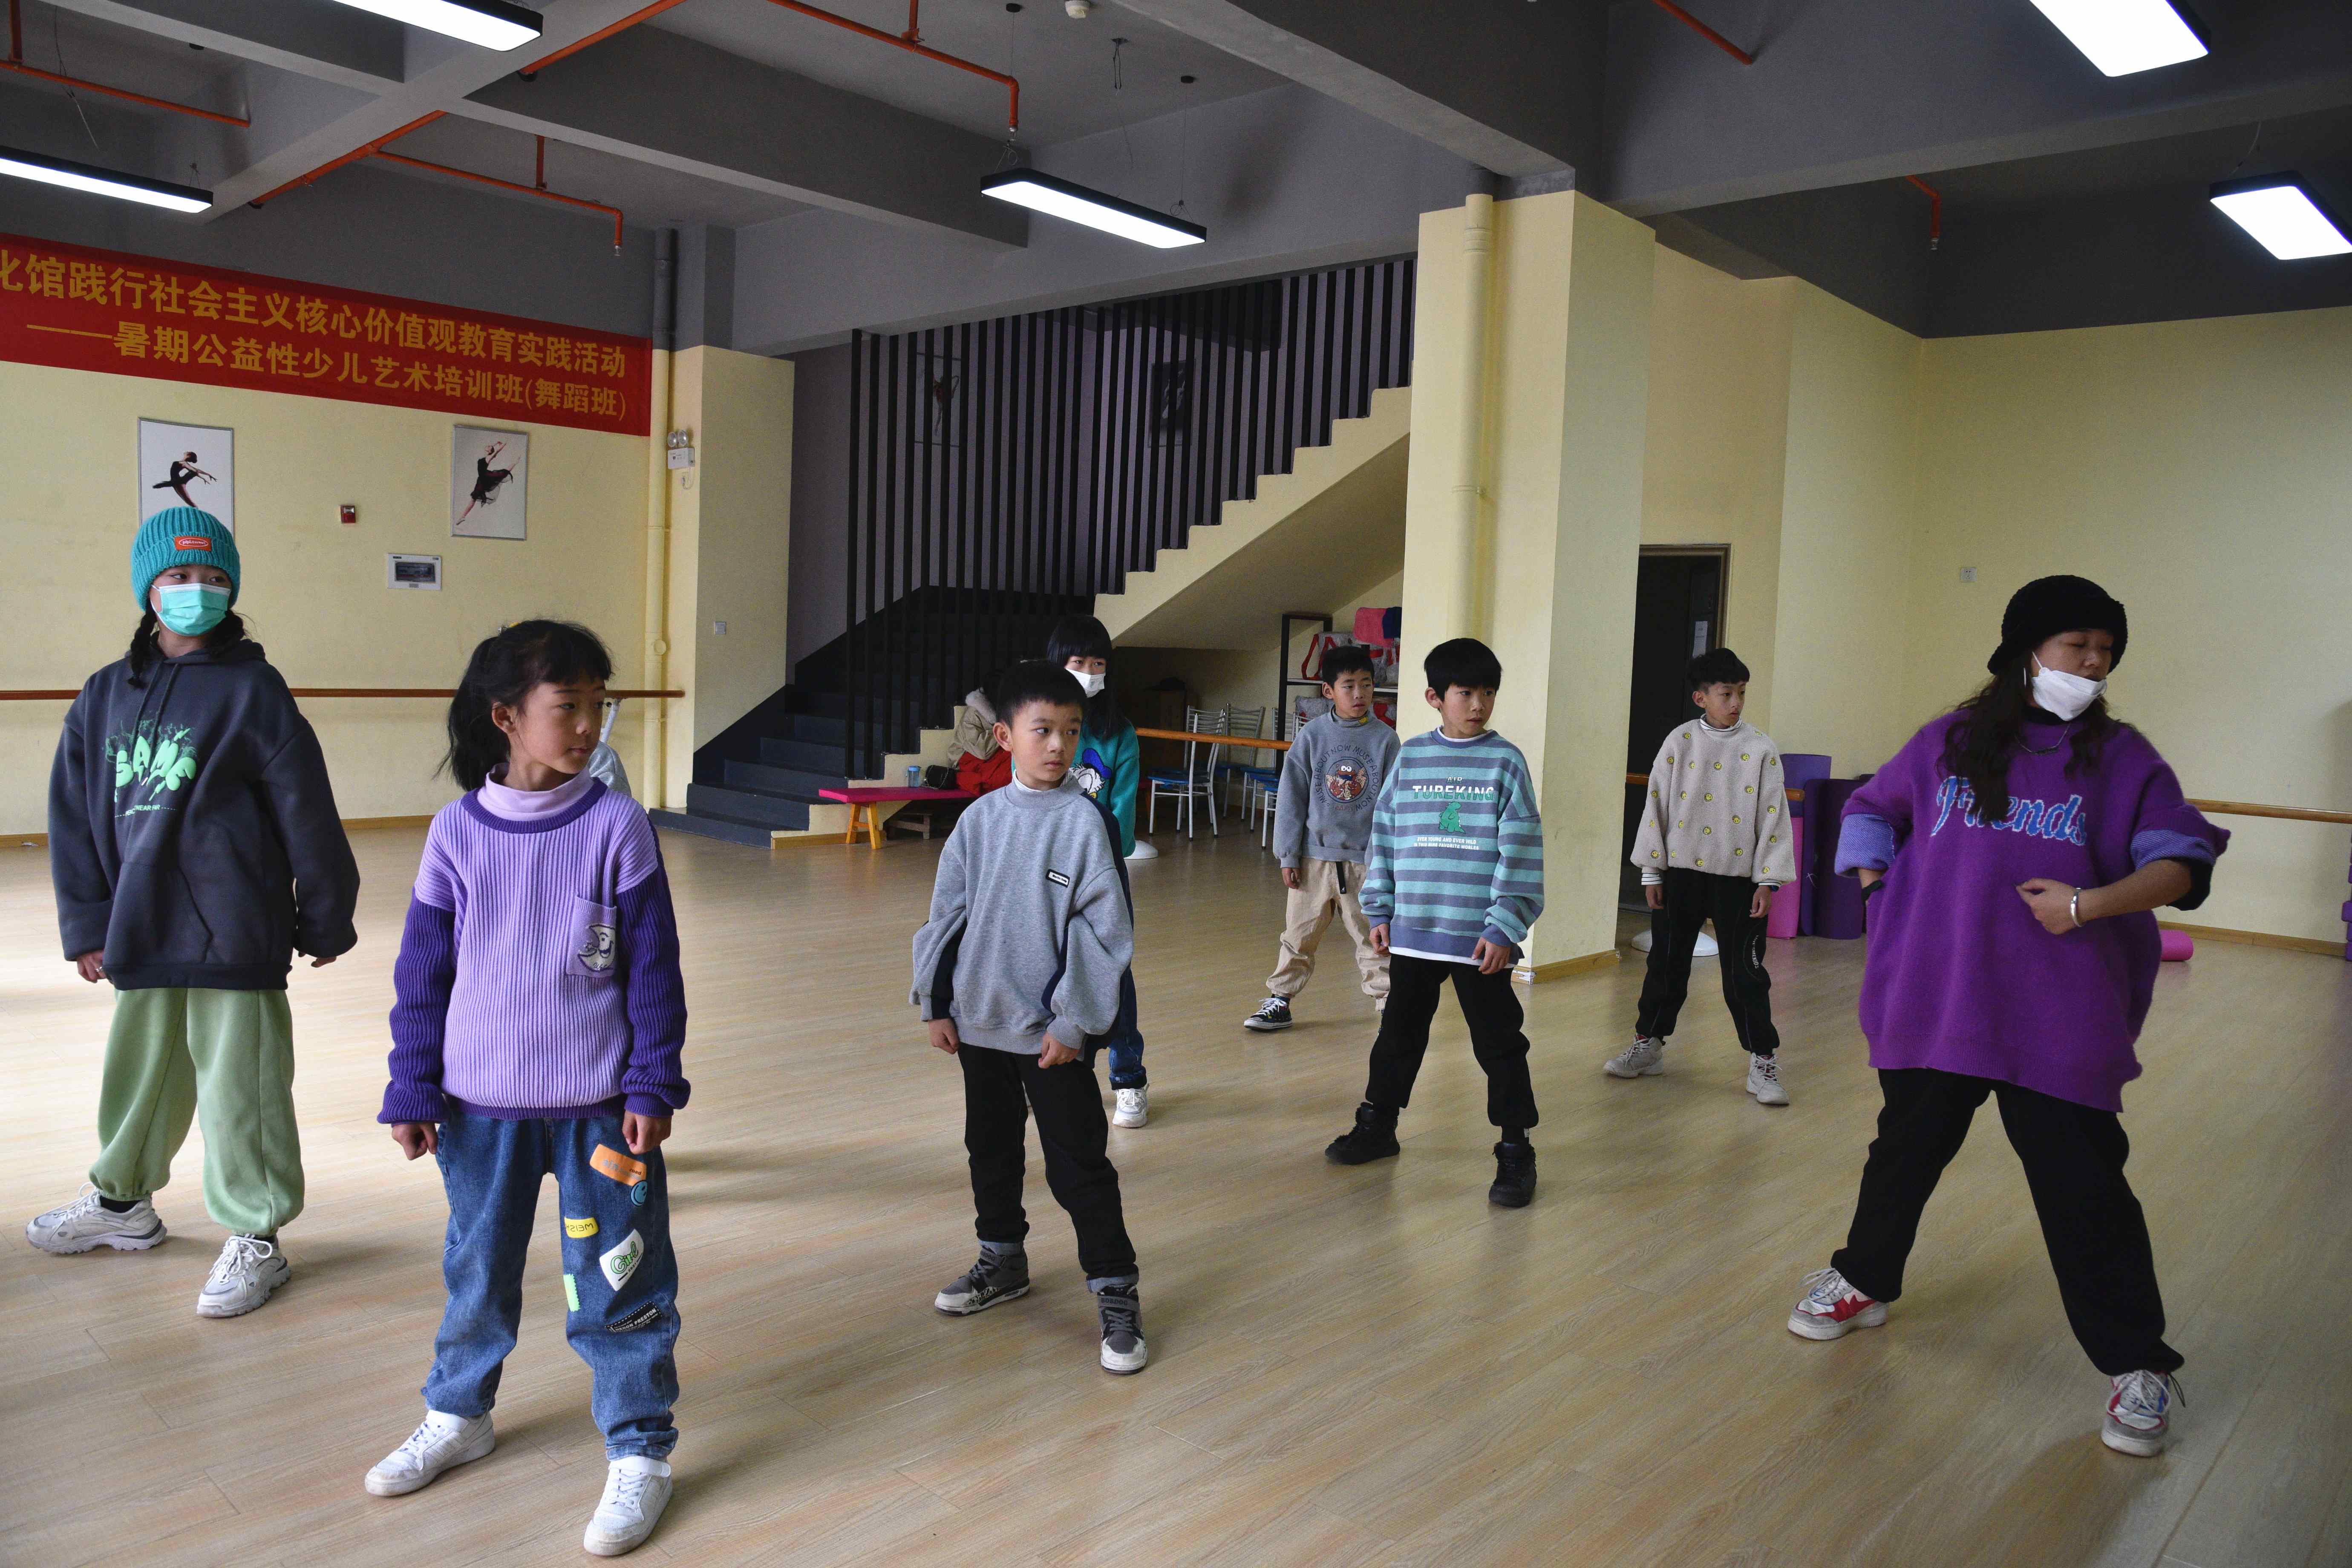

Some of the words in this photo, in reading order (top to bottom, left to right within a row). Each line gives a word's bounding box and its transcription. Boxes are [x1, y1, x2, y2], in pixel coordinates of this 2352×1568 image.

[1330, 744, 1351, 755] NOW
[610, 1241, 639, 1274] Girl
[634, 1308, 657, 1325] PRESTON
